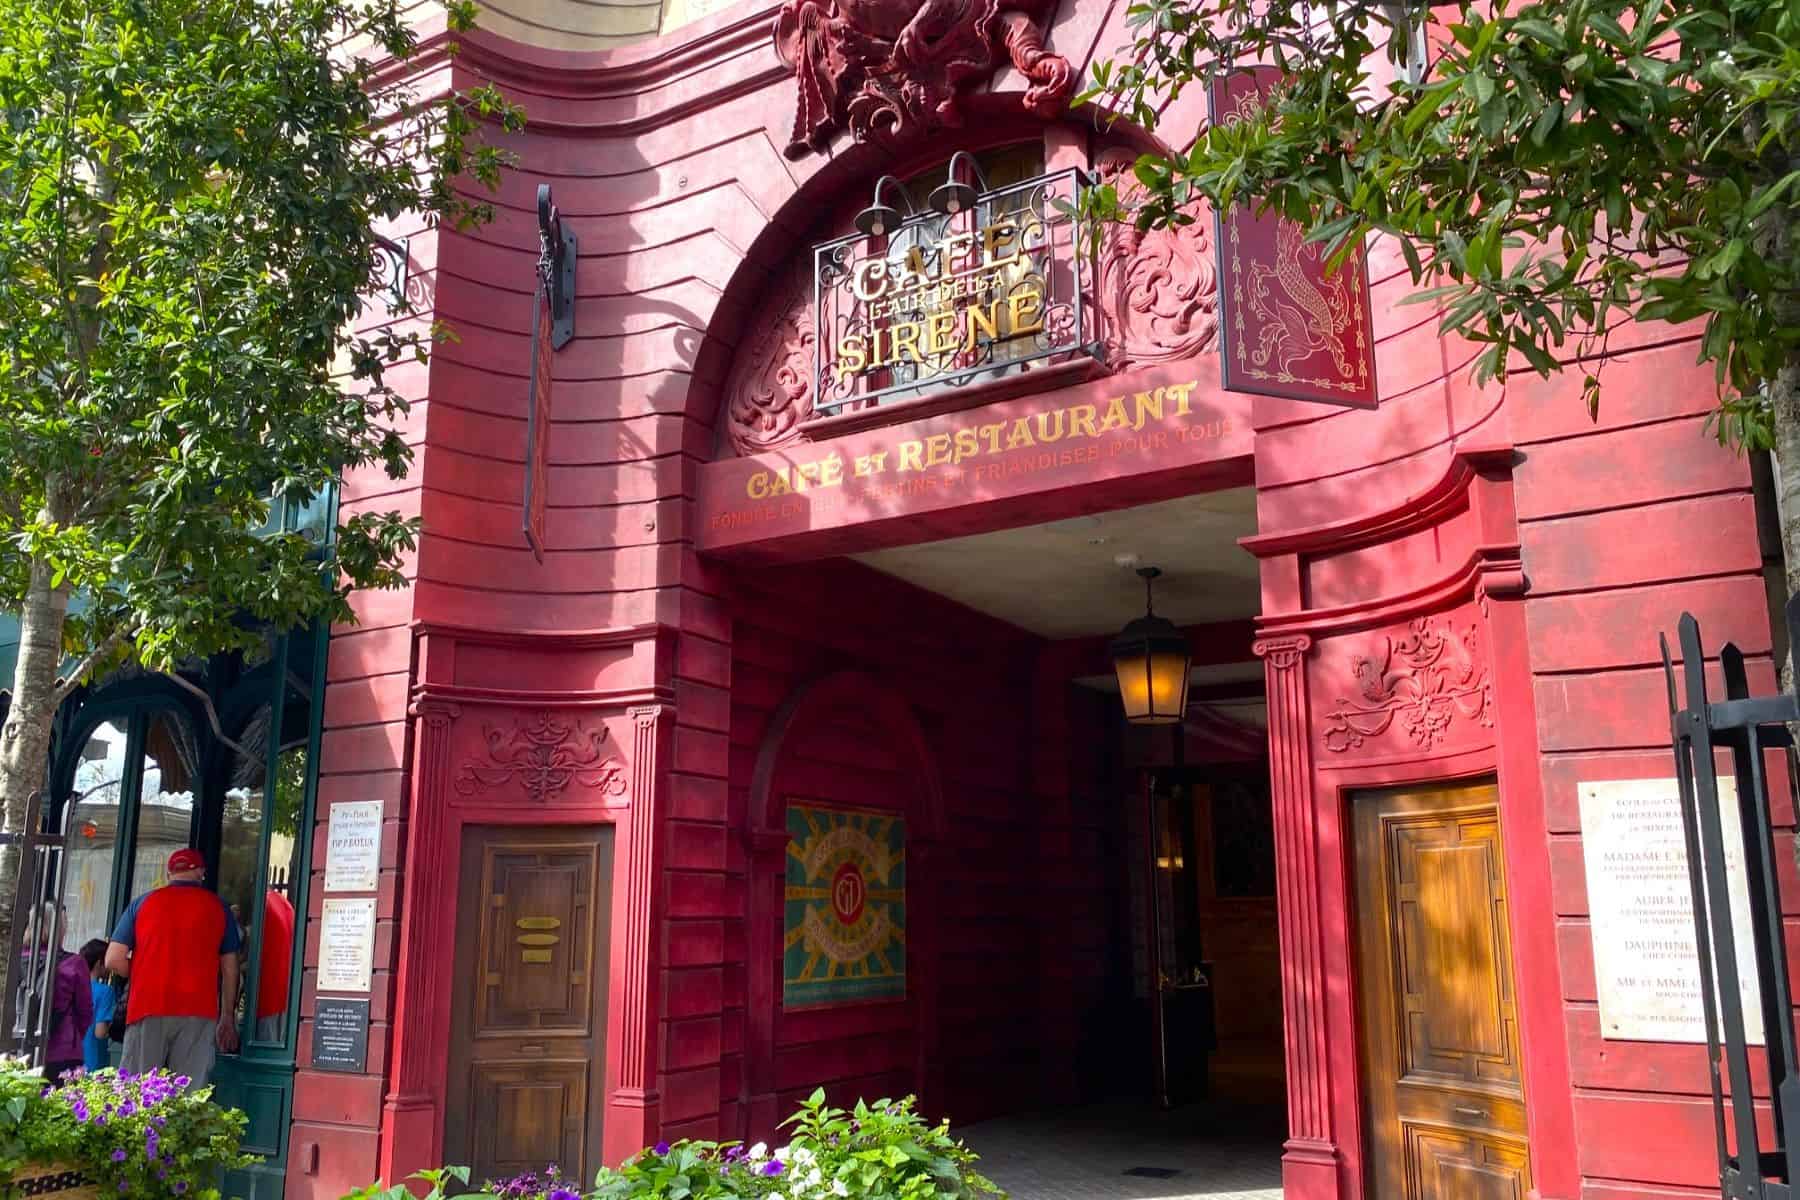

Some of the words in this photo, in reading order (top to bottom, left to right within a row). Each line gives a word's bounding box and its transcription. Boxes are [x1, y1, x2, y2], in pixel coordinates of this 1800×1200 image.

[746, 450, 844, 499] CAFÉ
[895, 380, 1199, 472] RESTAURANT
[974, 442, 1100, 482] FRIANDISES
[1110, 429, 1170, 457] POUR
